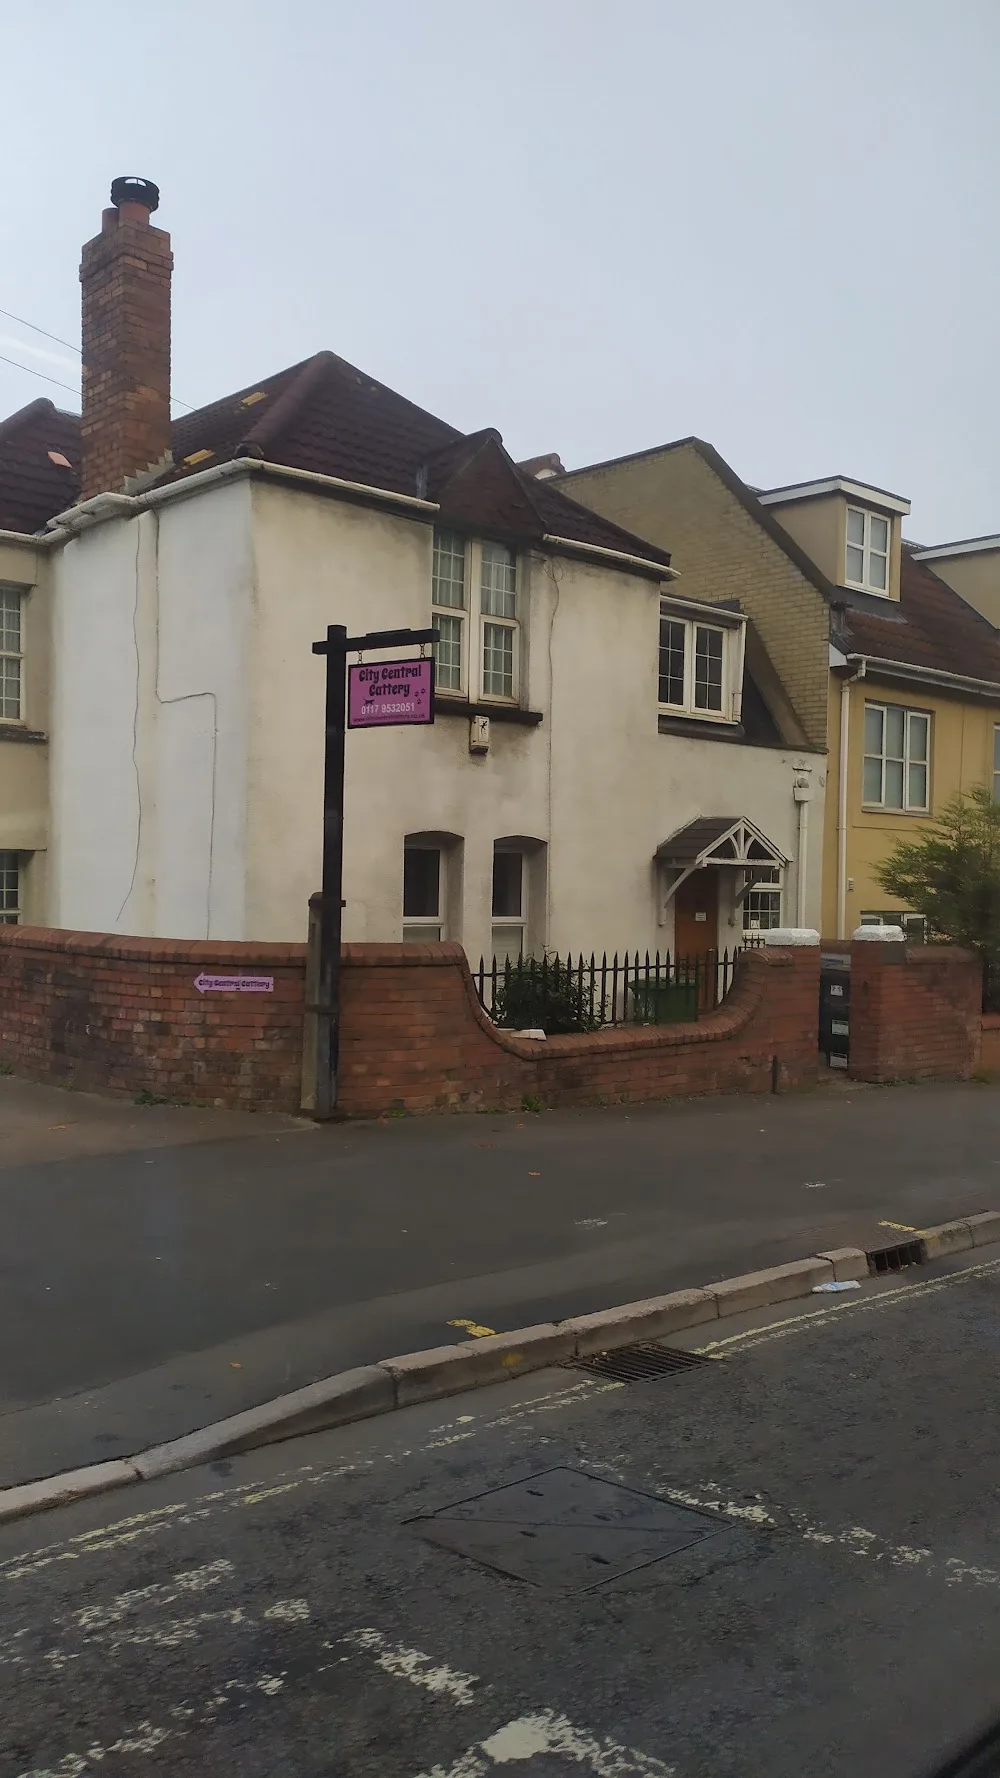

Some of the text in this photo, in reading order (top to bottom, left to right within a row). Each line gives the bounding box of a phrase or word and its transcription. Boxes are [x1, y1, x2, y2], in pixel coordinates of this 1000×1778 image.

[359, 664, 422, 684] City Central
[369, 684, 410, 697] Cattery
[361, 702, 415, 715] 0117 9532051
[198, 979, 270, 990] City Central Cattery
